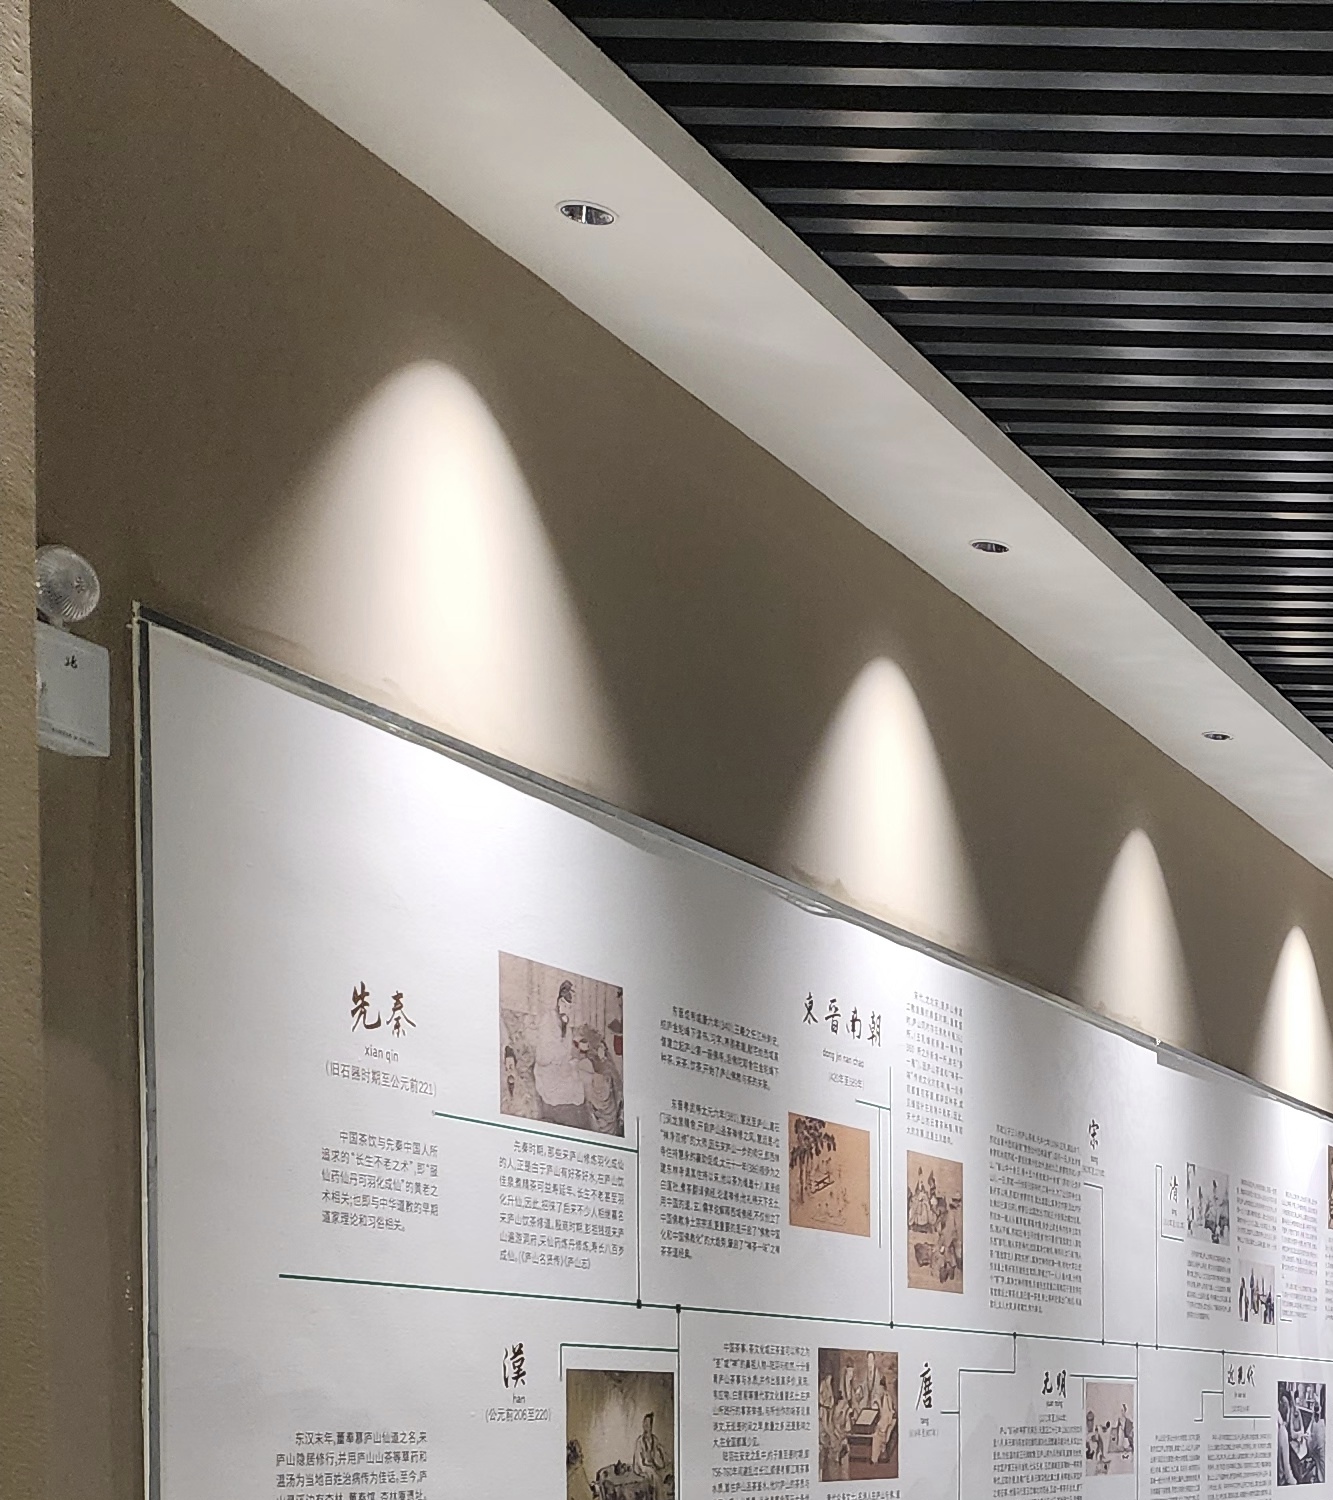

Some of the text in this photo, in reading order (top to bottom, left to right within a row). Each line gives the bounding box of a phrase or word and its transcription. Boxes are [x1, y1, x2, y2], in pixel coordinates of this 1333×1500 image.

[350, 979, 416, 1039] 先秦
[364, 1043, 399, 1062] xian qin
[502, 1342, 526, 1388] 漢
[915, 1362, 932, 1410] 唐
[1041, 1369, 1066, 1398] 元明
